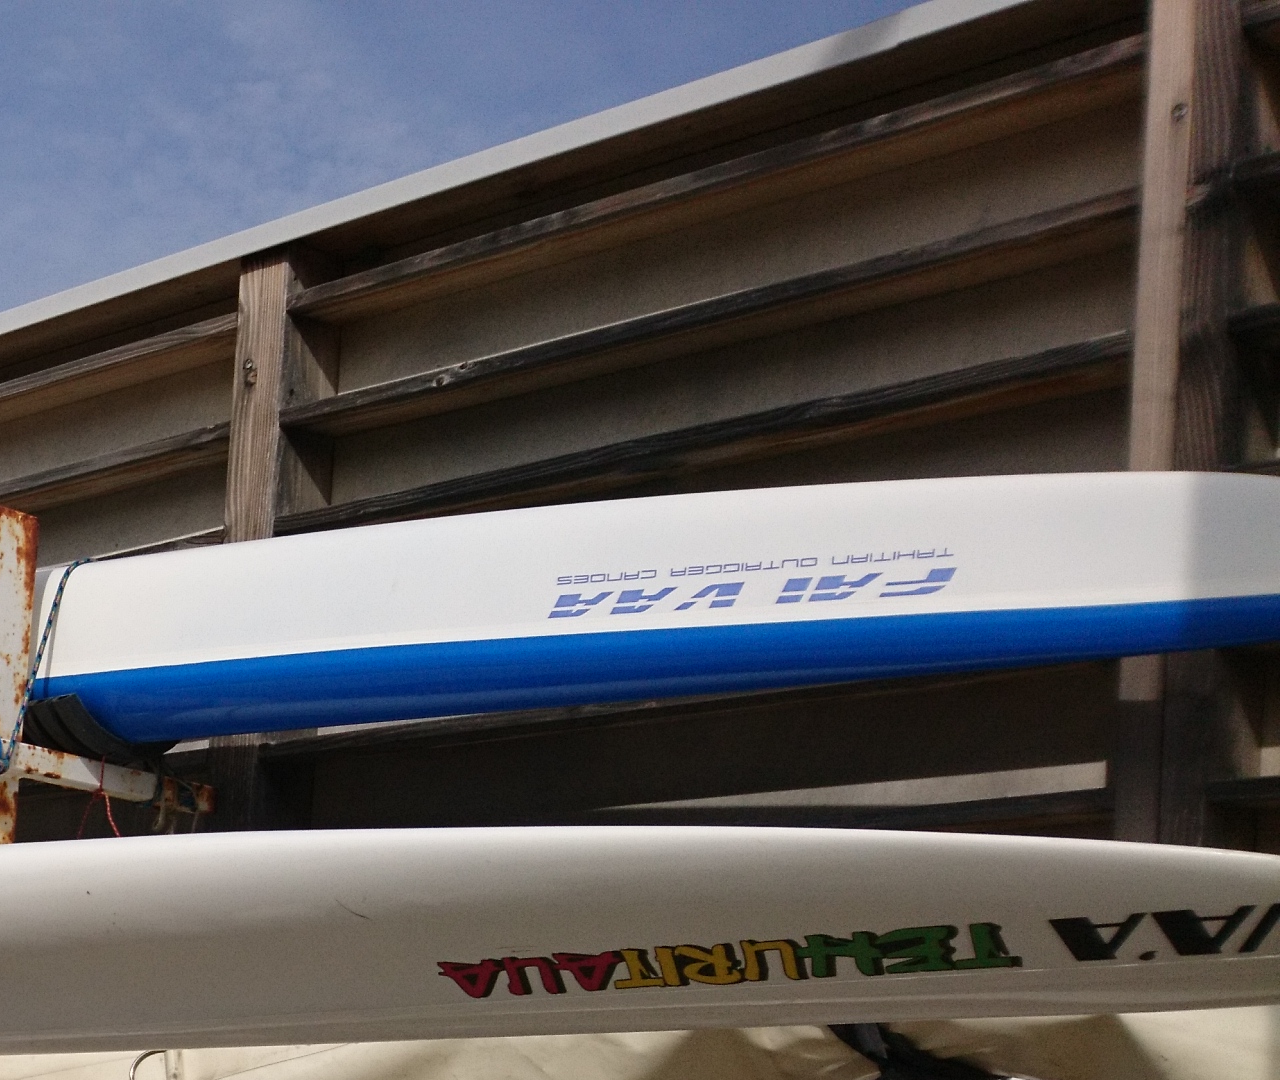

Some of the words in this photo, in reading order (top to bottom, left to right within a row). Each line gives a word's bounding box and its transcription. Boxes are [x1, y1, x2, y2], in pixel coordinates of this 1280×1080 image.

[832, 547, 955, 565] TAHITIAN
[556, 569, 657, 586] CANOES
[670, 557, 818, 578] OUTRIGGER
[775, 566, 958, 604] FAI
[547, 581, 746, 619] VAA
